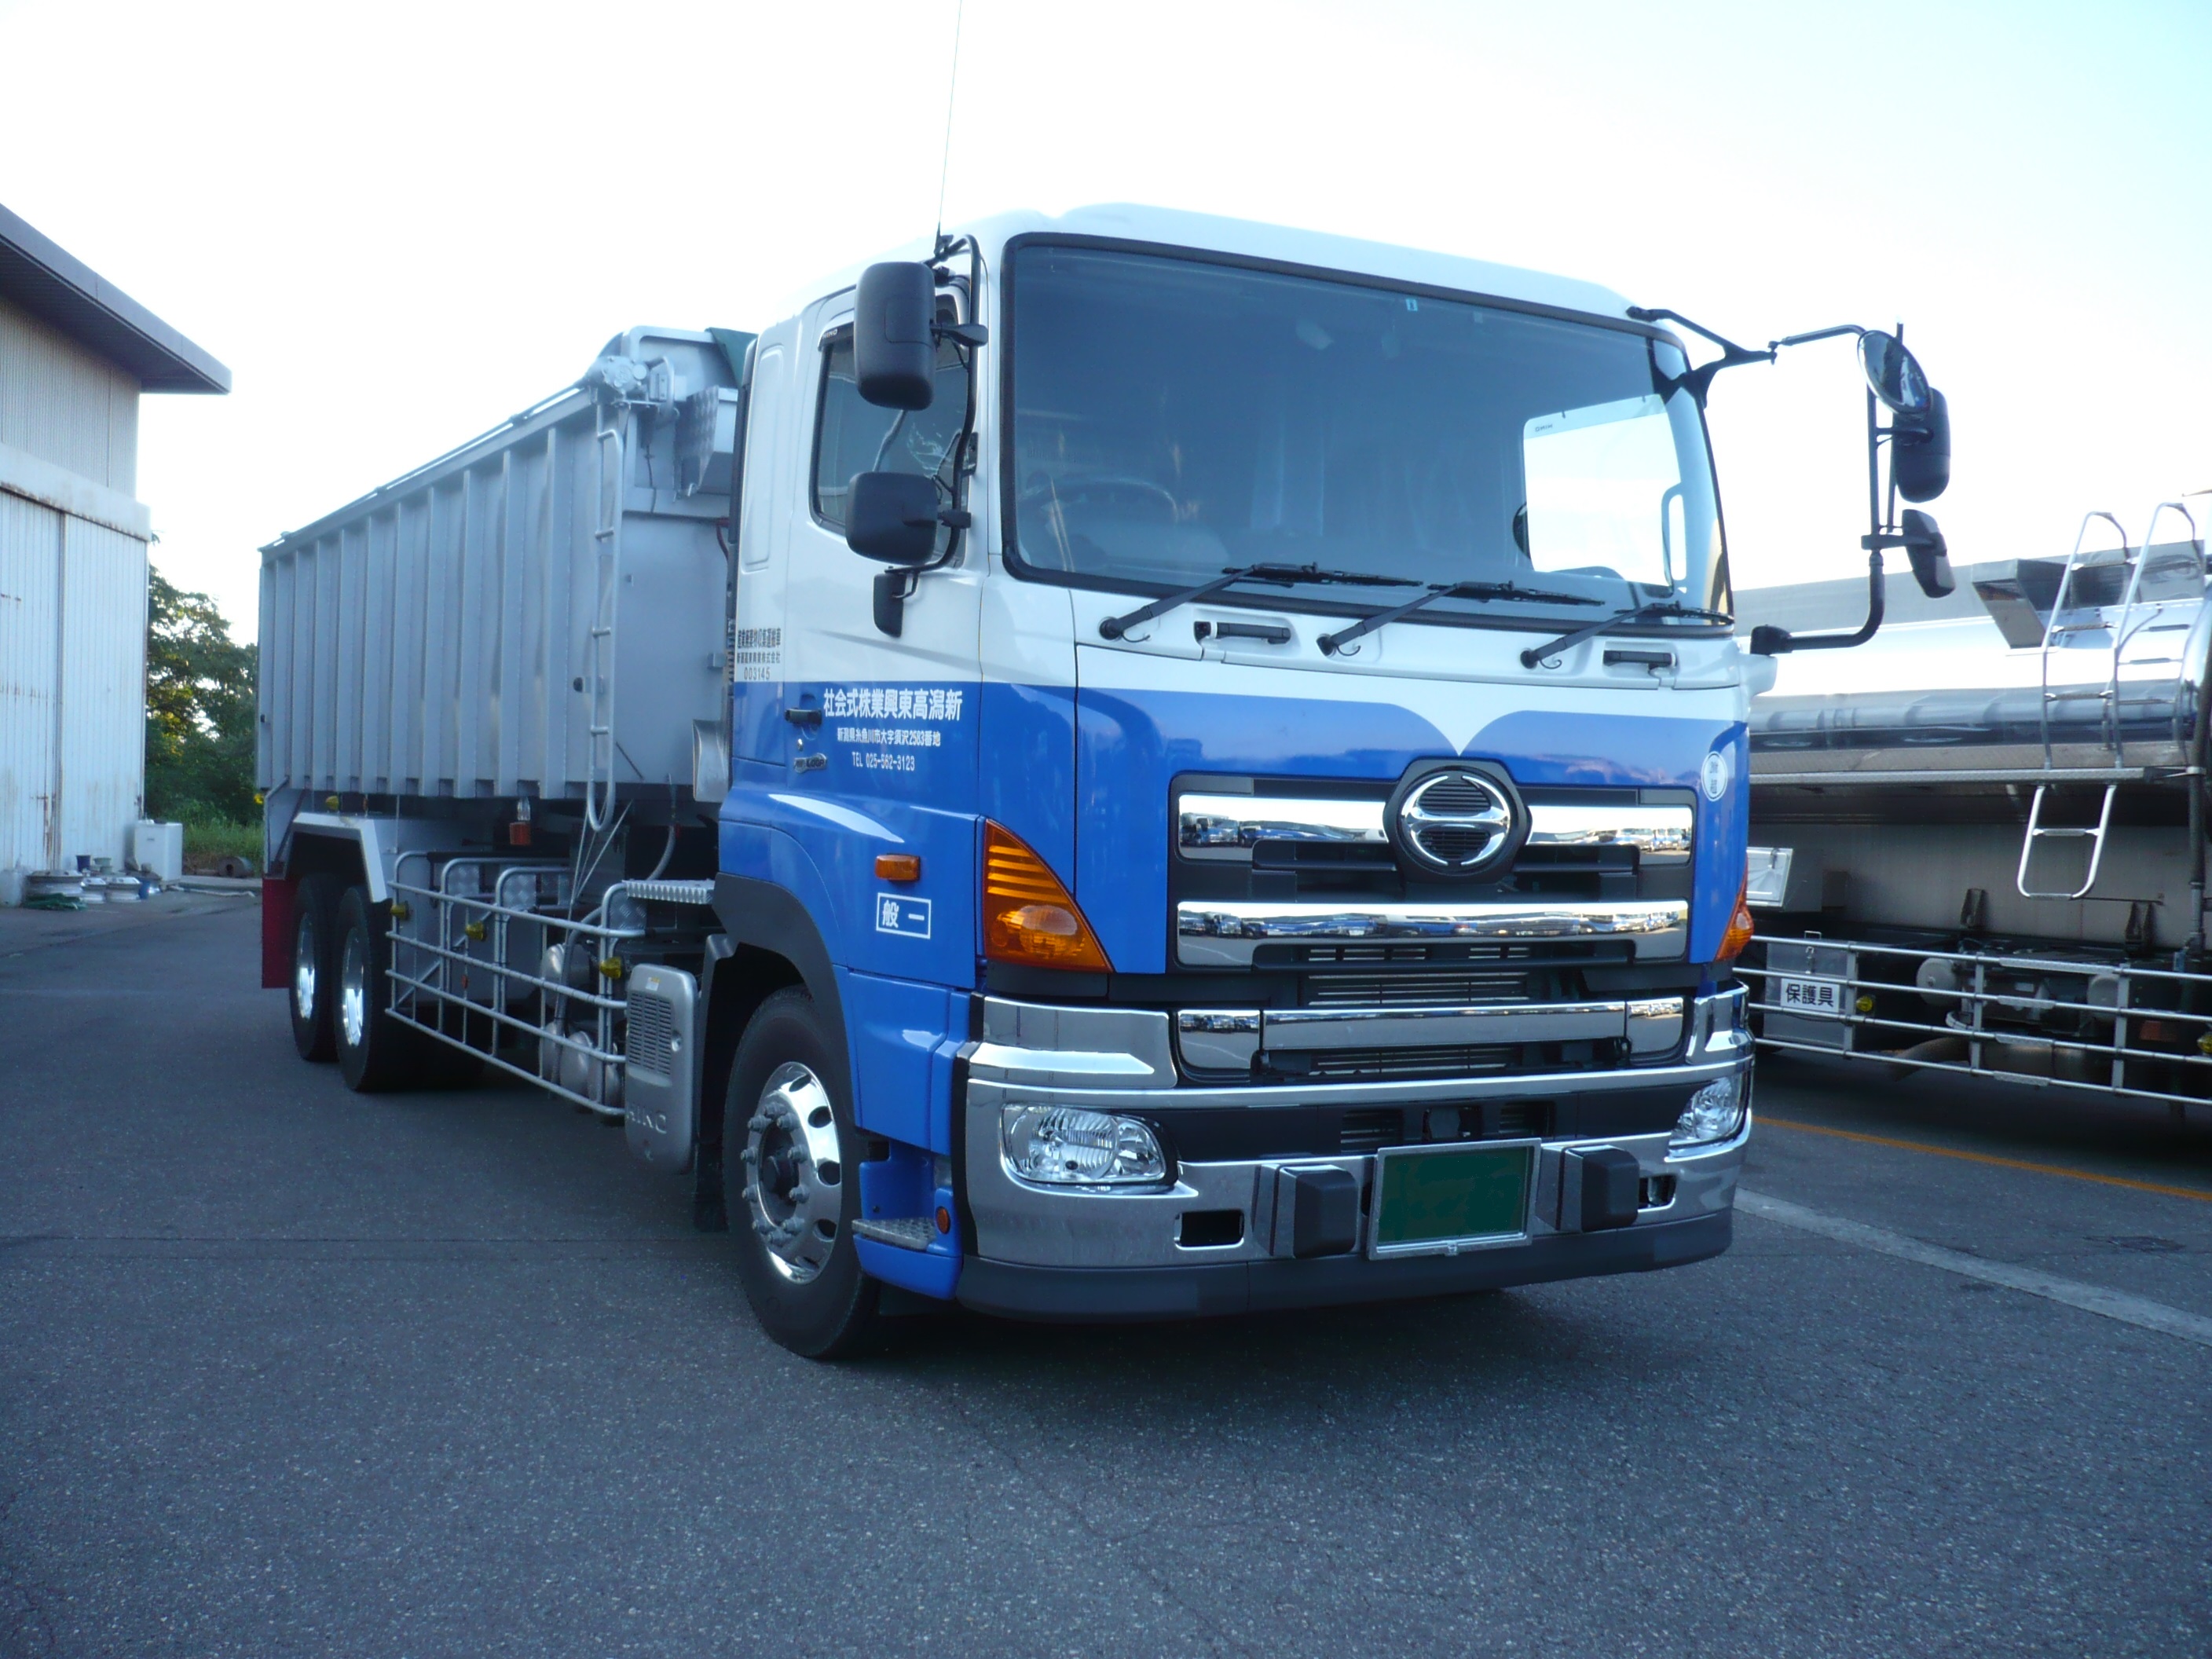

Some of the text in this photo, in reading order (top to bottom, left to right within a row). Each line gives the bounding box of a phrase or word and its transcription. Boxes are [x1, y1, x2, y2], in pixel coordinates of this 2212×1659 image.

[744, 667, 771, 681] 003145
[851, 752, 915, 771] TEL 025-562-3123
[1785, 983, 1834, 1007] 保護具
